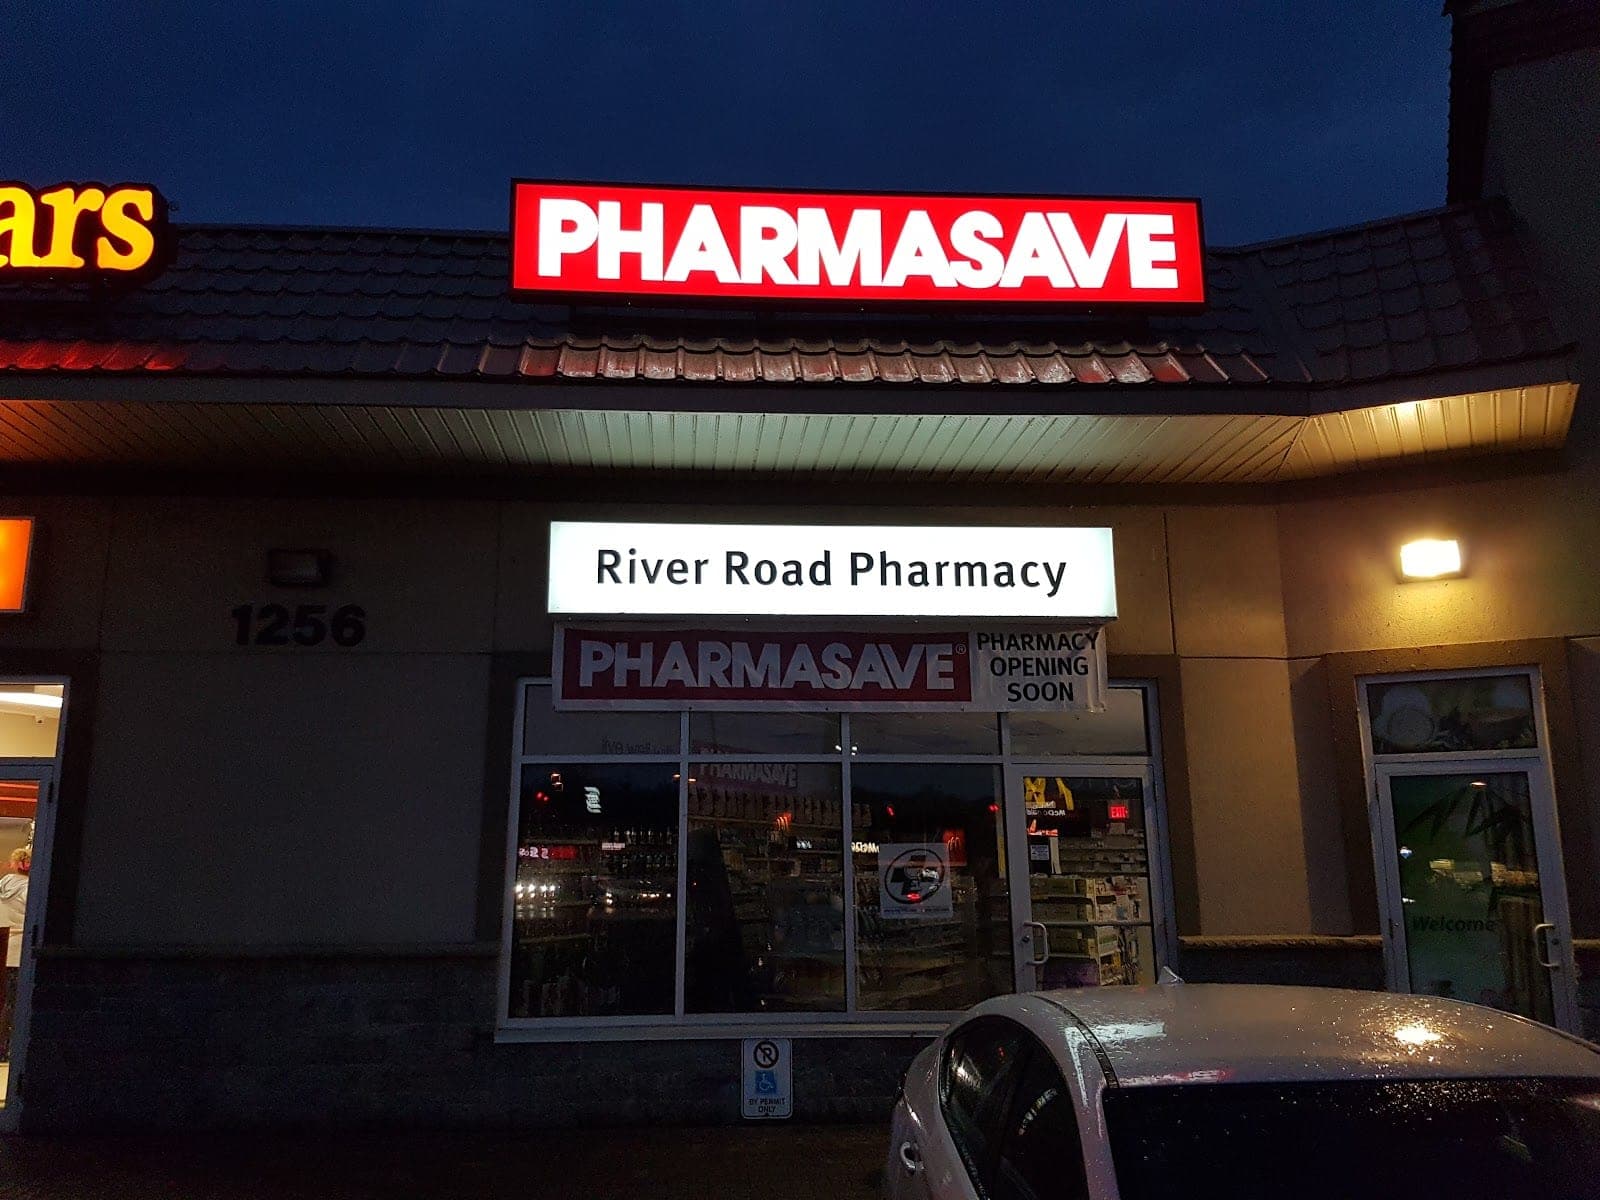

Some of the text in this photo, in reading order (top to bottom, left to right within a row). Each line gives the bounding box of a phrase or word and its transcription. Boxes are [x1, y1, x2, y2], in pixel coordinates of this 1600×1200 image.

[538, 198, 1178, 289] PHARMASAVE
[597, 548, 1067, 597] River Road Pharmacy
[231, 604, 367, 647] 1256
[977, 632, 1099, 651] PHARMACY
[990, 657, 1089, 677] OPENING
[1007, 682, 1074, 702] SOON
[1413, 915, 1497, 932] Welcome
[758, 1105, 776, 1113] ONLY
